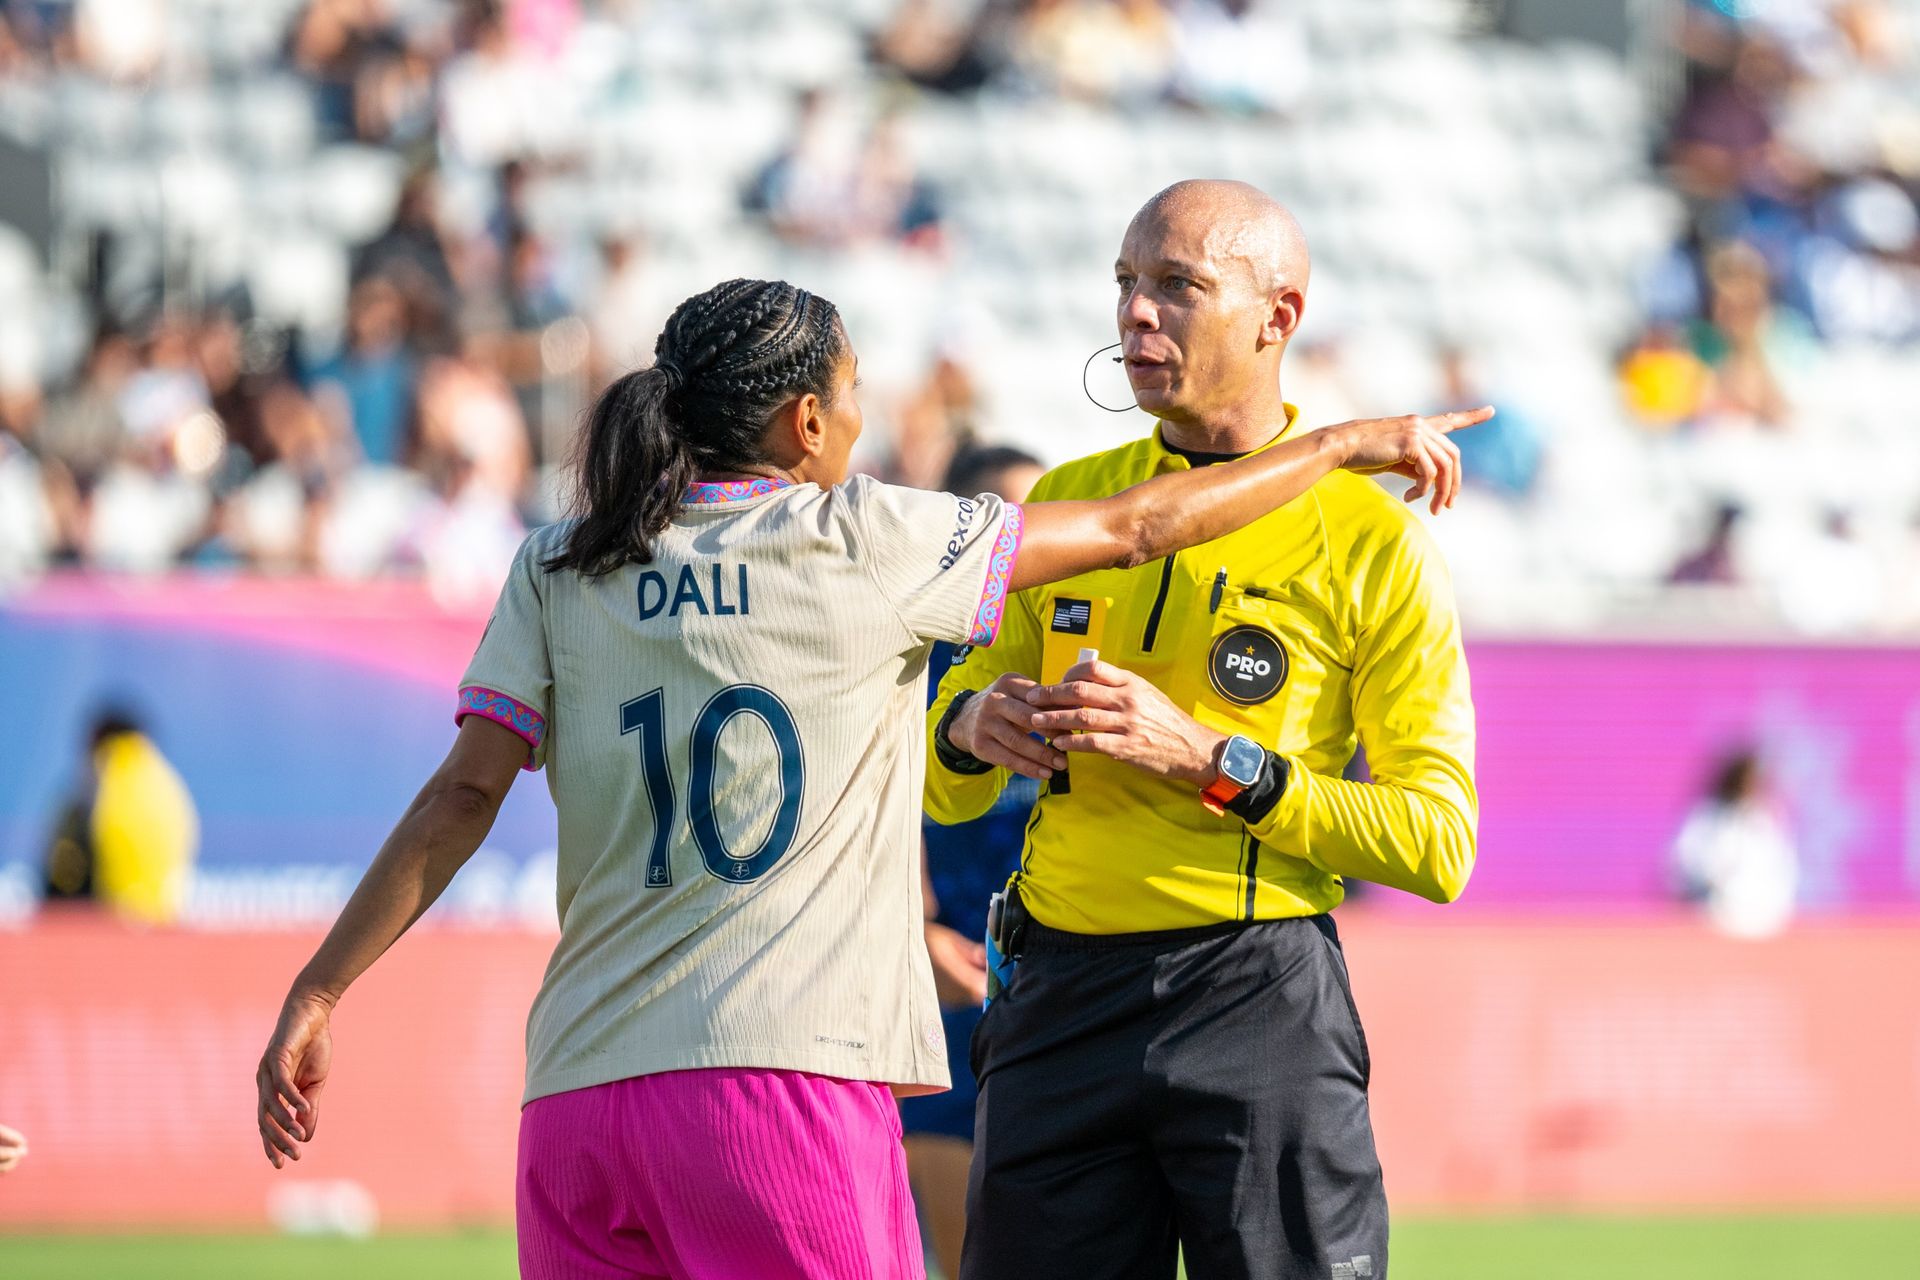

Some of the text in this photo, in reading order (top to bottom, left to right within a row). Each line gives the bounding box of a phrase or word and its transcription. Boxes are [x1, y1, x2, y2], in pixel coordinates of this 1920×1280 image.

[636, 563, 750, 622] DALI
[1225, 652, 1271, 676] PRO
[619, 683, 807, 888] 10
